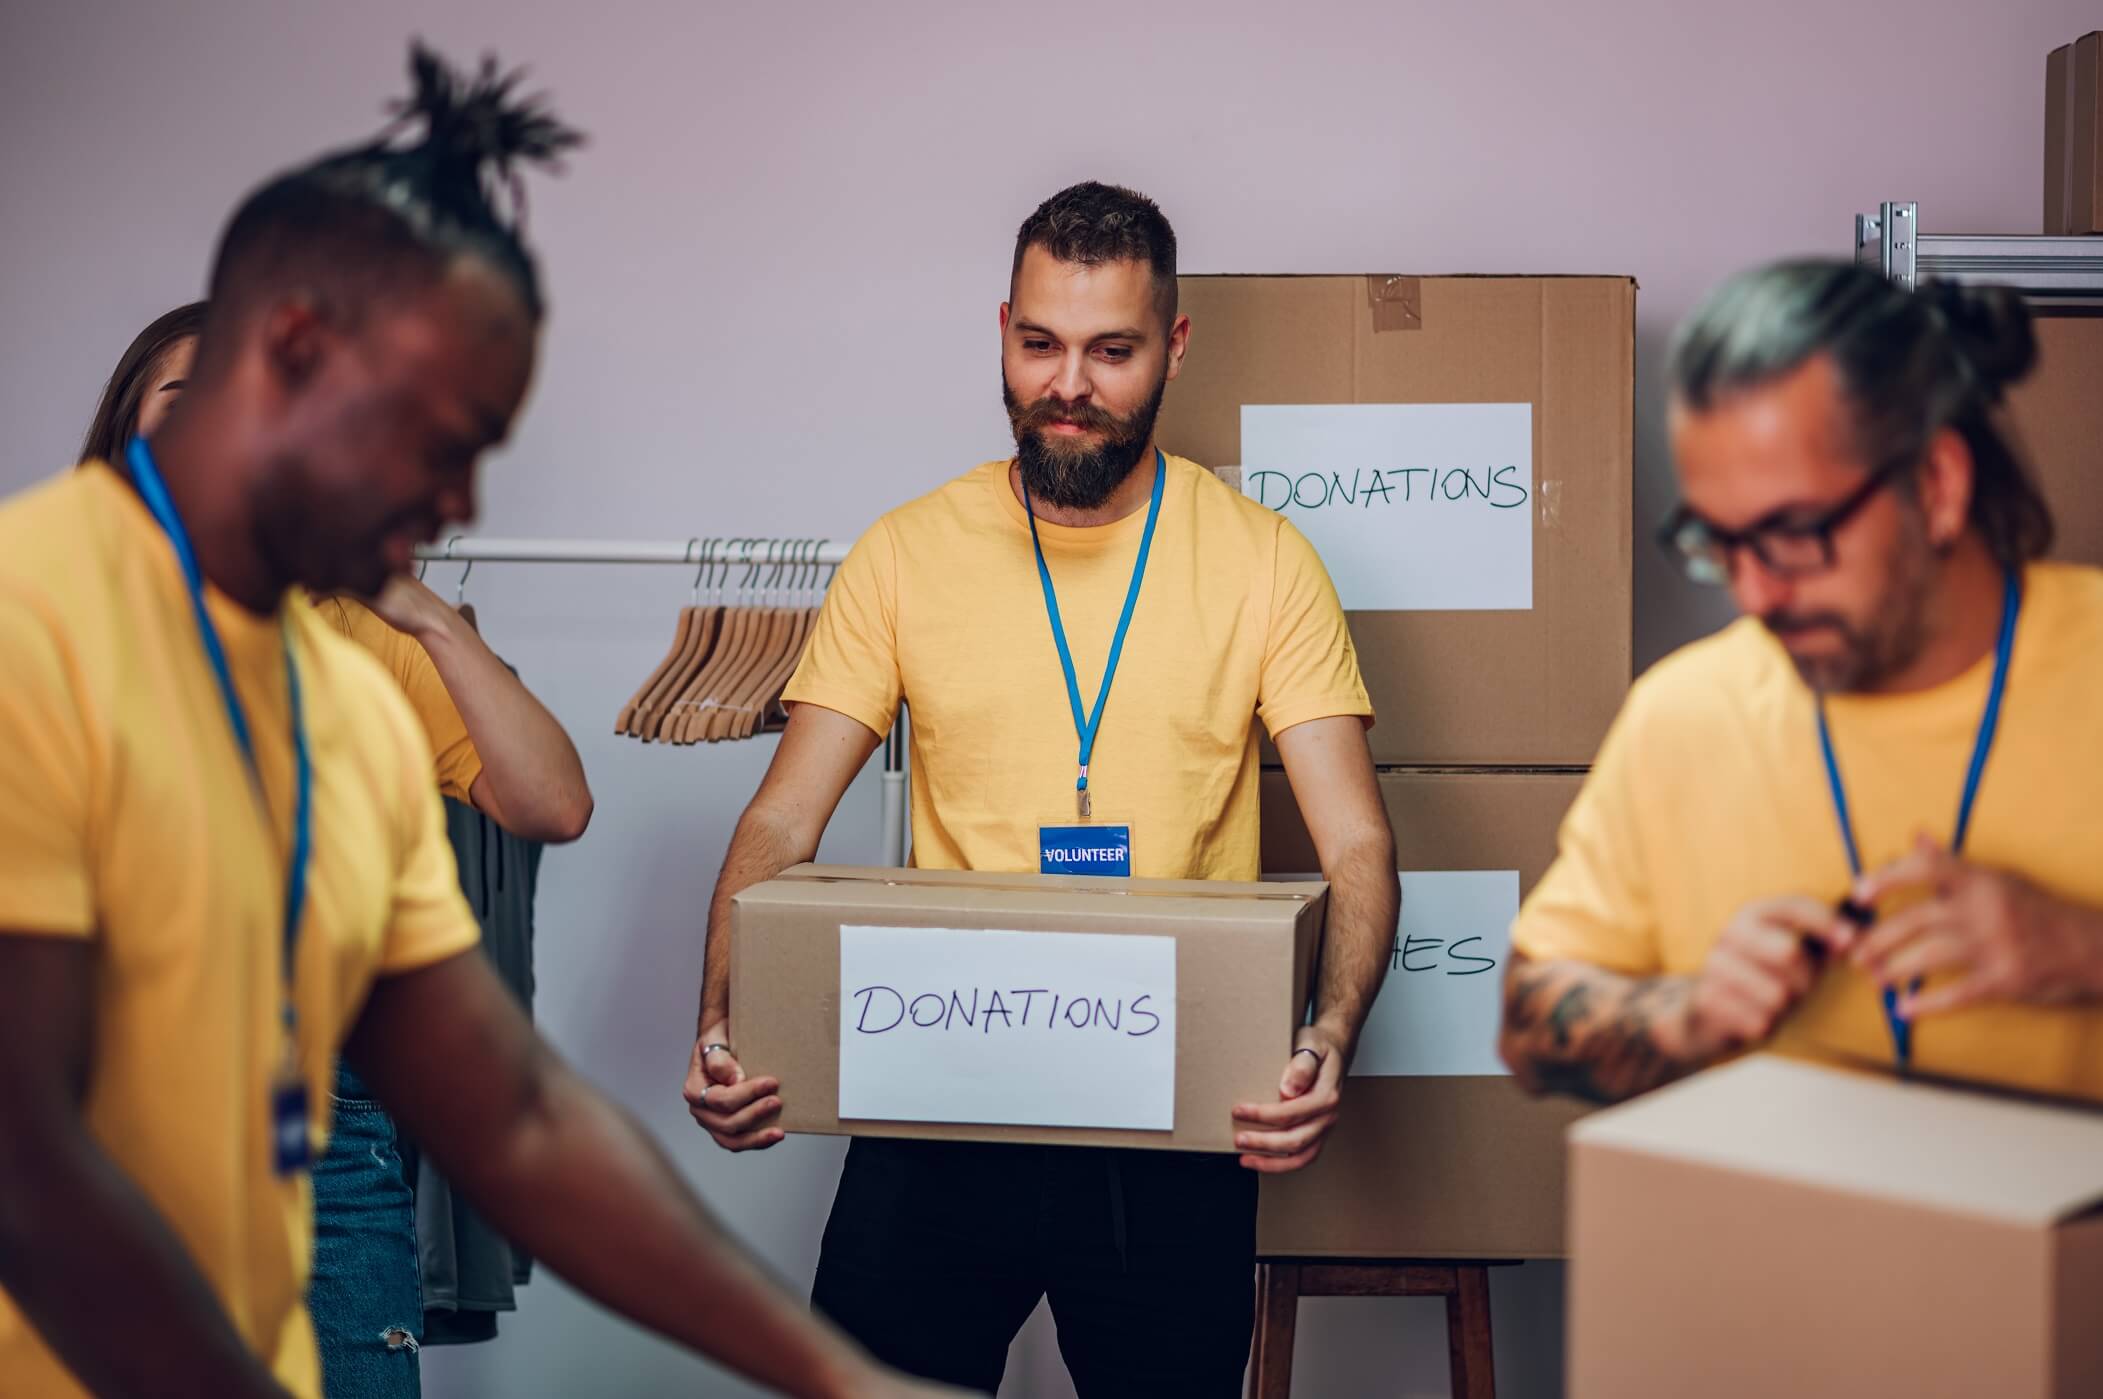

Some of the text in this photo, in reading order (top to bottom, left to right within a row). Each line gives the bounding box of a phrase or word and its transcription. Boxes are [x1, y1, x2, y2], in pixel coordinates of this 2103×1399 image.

[1249, 465, 1528, 511] DONATIONS
[1045, 847, 1125, 862] VOLUNTEER
[854, 986, 1160, 1037] DONATIONS
